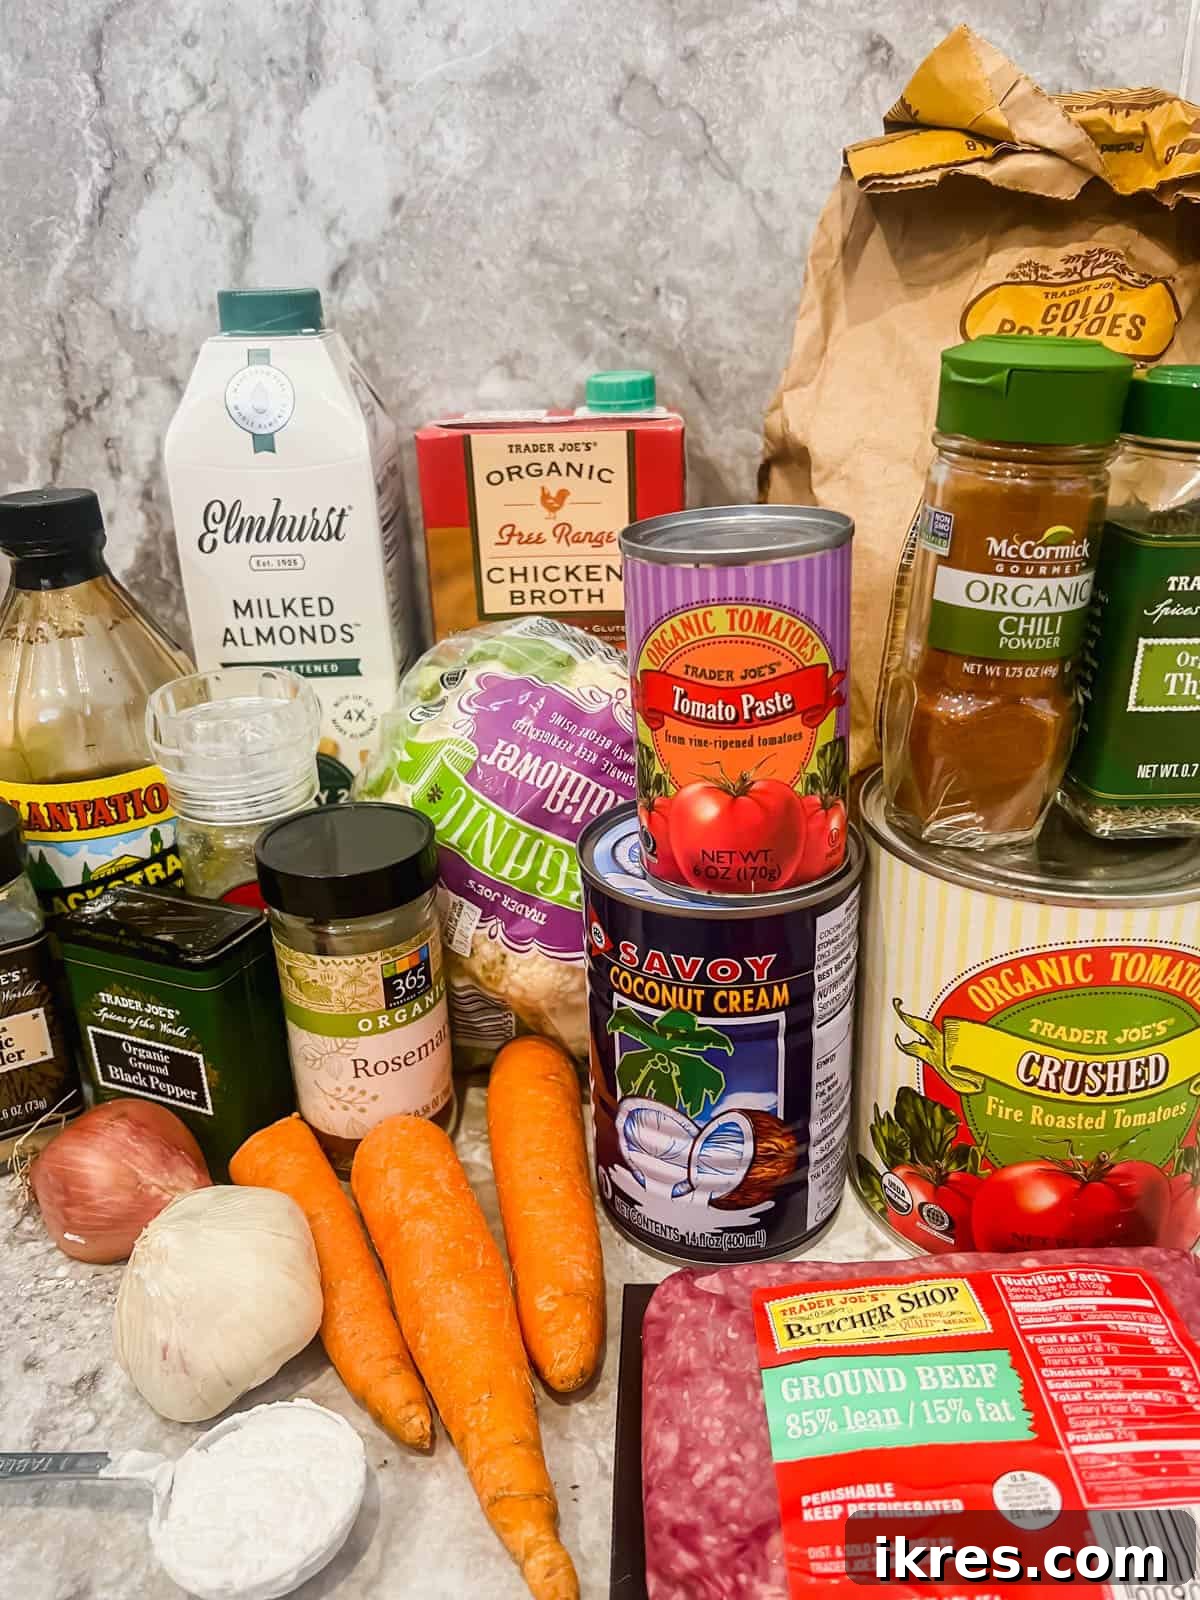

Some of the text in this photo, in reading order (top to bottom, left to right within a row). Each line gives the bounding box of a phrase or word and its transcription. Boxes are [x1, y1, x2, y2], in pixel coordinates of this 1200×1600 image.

[1043, 284, 1091, 300] TRADER
[1041, 292, 1115, 326] GOLD
[508, 441, 593, 455] TRADER JOE'S
[485, 461, 615, 487] ORGANIC
[198, 498, 350, 553] Elmhurst
[495, 522, 617, 548] Free Range
[986, 536, 1091, 560] McCormick
[256, 560, 273, 568] Est.
[486, 564, 623, 584] CHICKEN
[995, 563, 1081, 577] GOURMET
[510, 588, 604, 606] BROTH
[964, 578, 1092, 608] ORGANIC
[233, 596, 335, 620] MILKED
[222, 623, 355, 647] ALMONDS
[645, 607, 821, 668] ORGANIC TOMATOES
[998, 615, 1063, 637] CHILI
[999, 635, 1061, 650] POWDER
[684, 663, 777, 682] TRADER JOE'S
[962, 662, 983, 676] NET
[1004, 664, 1023, 677] 1.75
[1024, 665, 1040, 677] OZ
[672, 685, 794, 722] Tomato Paste
[343, 708, 366, 723] 4X
[550, 711, 577, 735] USING
[512, 719, 573, 755] REFRIGERATED
[577, 726, 613, 749] BEFORE
[664, 730, 804, 751] from vine-ripened tomatoes
[575, 742, 598, 765] KEEP
[1137, 763, 1199, 779] NET WT. 0.7
[701, 850, 737, 865] NET
[704, 865, 732, 881] OZ
[736, 864, 782, 882] (170g)
[467, 879, 548, 926] TRADER JOE'S
[618, 940, 777, 984] SAVOY
[392, 966, 426, 999] 365
[818, 967, 833, 983] BEST
[968, 953, 1094, 1013] ORGANIC
[609, 965, 790, 1014] COCONUT CREAM
[98, 992, 177, 1020] TRADER JOE'S
[93, 1006, 191, 1039] Spices of the World
[1028, 1018, 1170, 1045] TRADER JOE'S
[122, 1041, 171, 1064] Organic
[128, 1057, 169, 1077] Ground
[1017, 1051, 1169, 1096] CRUSHED
[107, 1064, 199, 1101] Black Pepper
[10, 1098, 48, 1117] OZ (73g)
[986, 1096, 1187, 1130] Fire Roasted Tomatoes
[614, 1198, 631, 1214] NET
[630, 1208, 681, 1242] CONTENTS
[722, 1231, 744, 1251] (400
[1000, 1271, 1112, 1287] Nutrition Facts
[779, 1298, 836, 1318] TRADER
[840, 1293, 880, 1307] JOE'S
[784, 1303, 895, 1342] BUTCHER
[897, 1286, 960, 1315] SHOP
[1026, 1335, 1057, 1344] Total
[1059, 1335, 1080, 1344] Fat
[1087, 1344, 1105, 1353] Fat
[1041, 1367, 1111, 1377] Cholesterol
[1072, 1356, 1088, 1365] Fat
[780, 1363, 999, 1402] GROUND BEEF
[1045, 1380, 1093, 1390] Sodium
[1051, 1391, 1161, 1403] Total Carbohydrate
[785, 1408, 838, 1439] 85%
[842, 1405, 902, 1433] lean
[918, 1398, 972, 1425] 15%
[976, 1396, 1016, 1424] fat
[1066, 1431, 1115, 1443] Protein
[800, 1482, 896, 1507] PERISHABLE
[802, 1499, 965, 1522] KEEP REFRIGERATED
